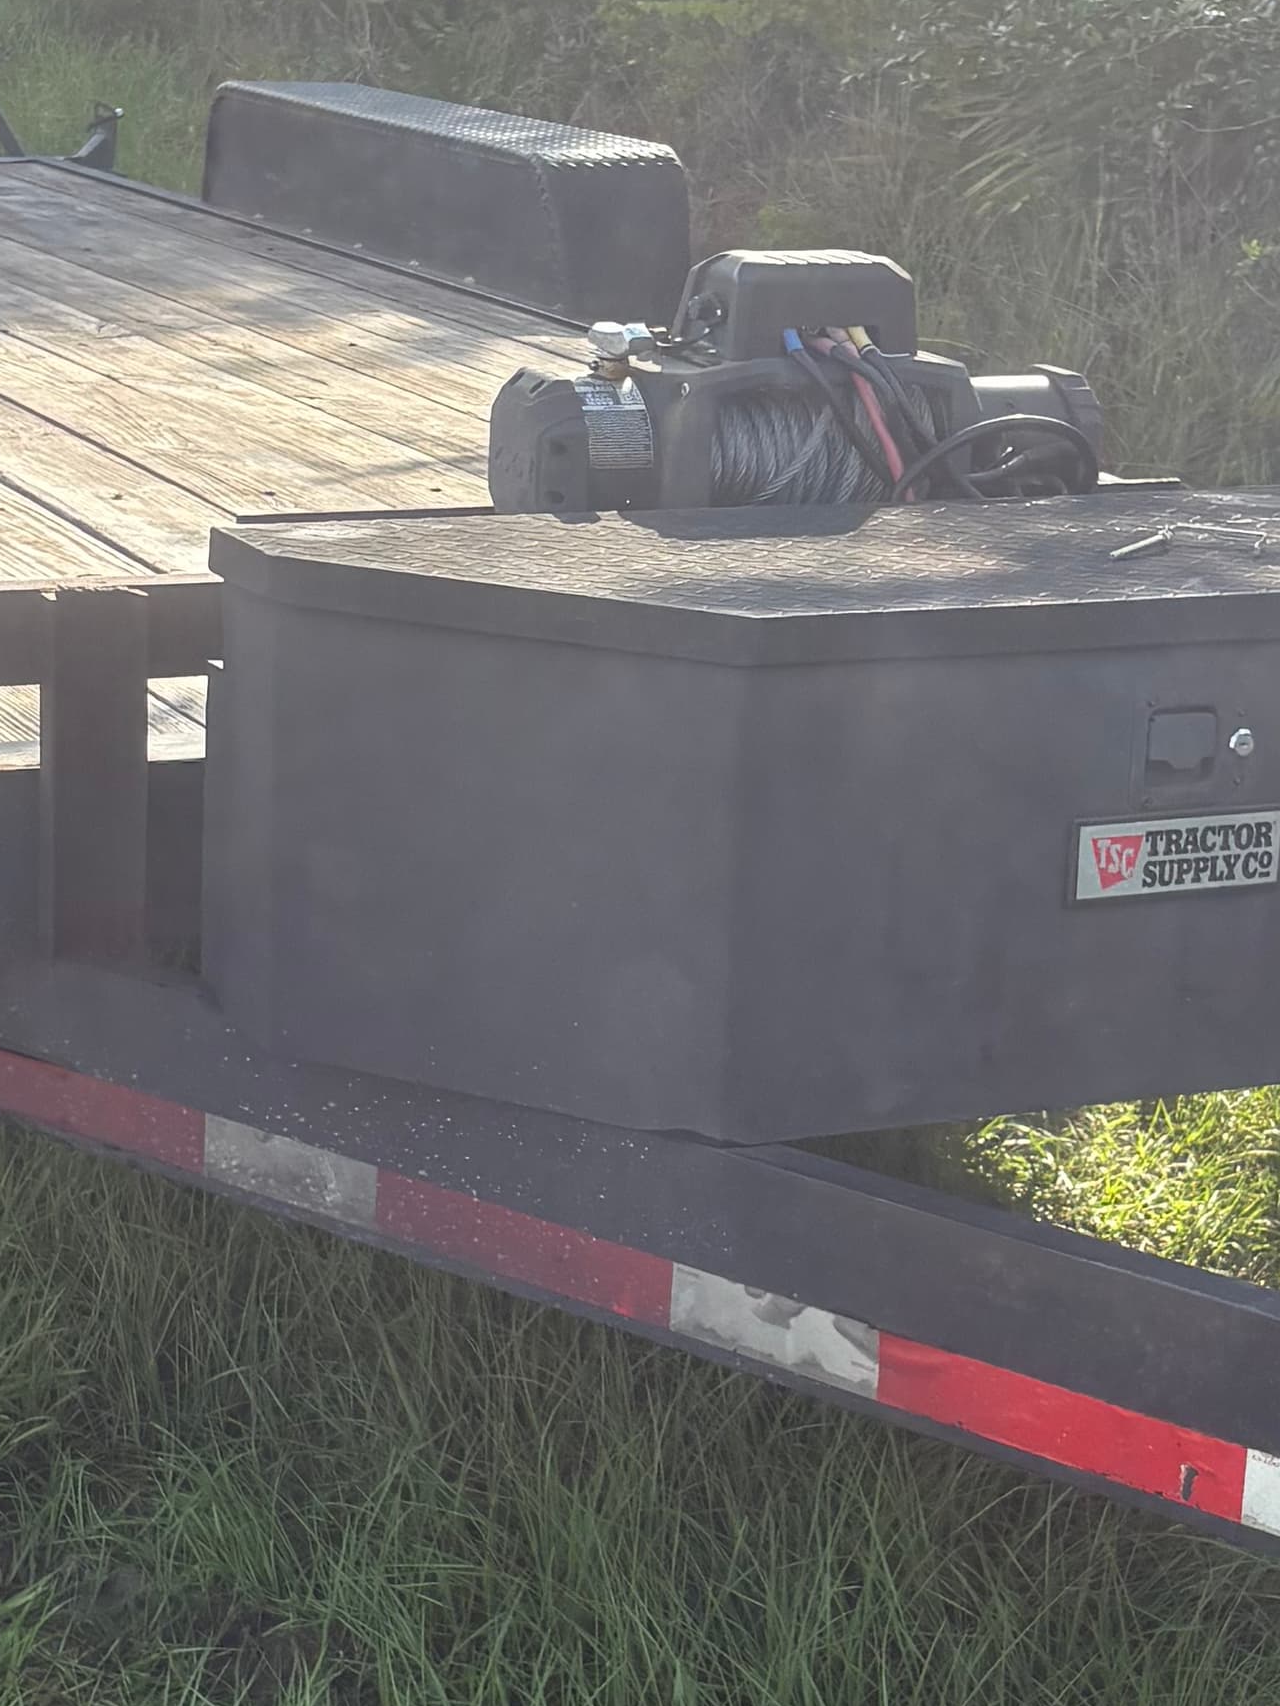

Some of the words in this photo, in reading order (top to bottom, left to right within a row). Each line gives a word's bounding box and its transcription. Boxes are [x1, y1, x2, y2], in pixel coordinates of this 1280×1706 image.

[1145, 821, 1273, 857] TRACTOR
[1096, 839, 1135, 880] TSC
[1142, 852, 1241, 889] SUPPLY
